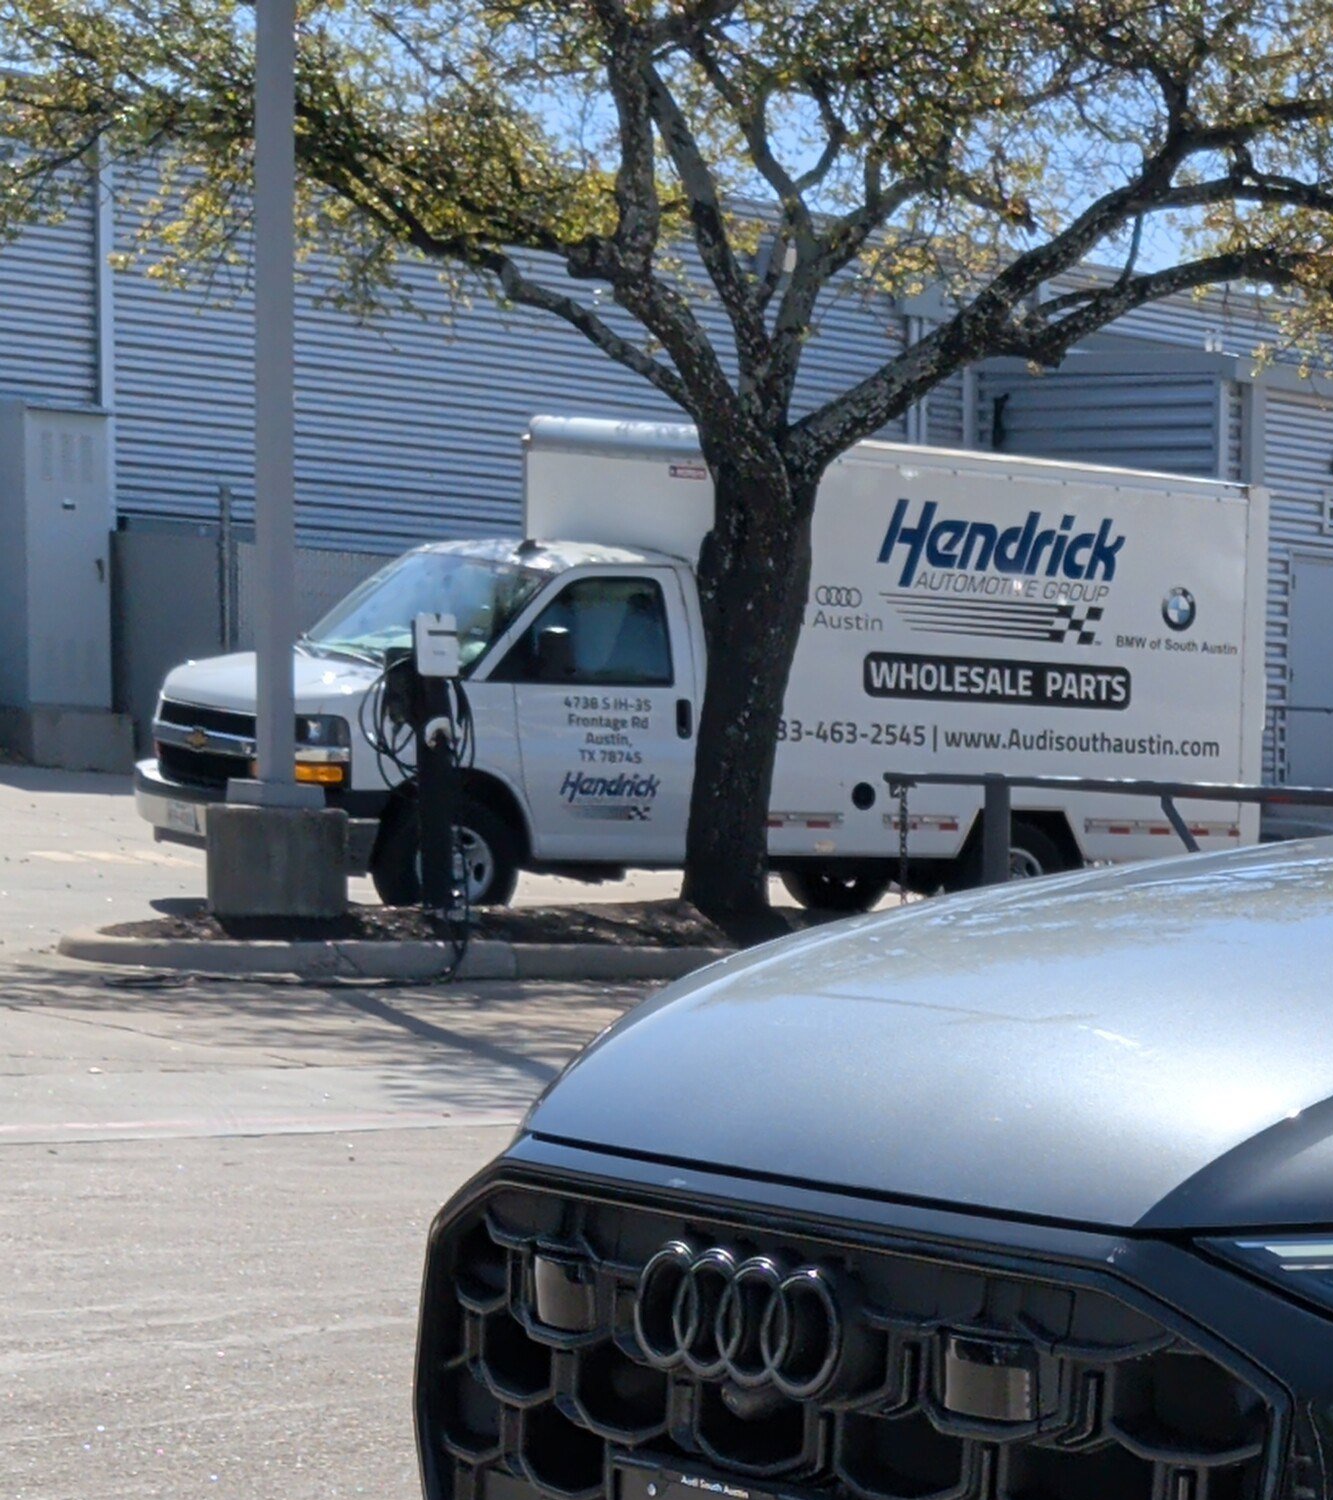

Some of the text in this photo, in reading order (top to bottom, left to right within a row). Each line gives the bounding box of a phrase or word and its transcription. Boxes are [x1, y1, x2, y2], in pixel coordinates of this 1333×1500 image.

[877, 499, 1126, 588] Hendrick
[1042, 582, 1110, 602] GROUP
[813, 611, 883, 631] Austin
[1116, 635, 1147, 649] BMW
[1149, 637, 1162, 650] of
[1165, 637, 1198, 652] South
[1201, 641, 1238, 655] Austin
[870, 661, 1127, 702] WHOLESALE PARTS
[568, 714, 649, 731] Frontage Rd
[944, 728, 1220, 757] www.Audisouthaustin.com
[578, 749, 596, 762] TX
[560, 771, 661, 803] Hendrick
